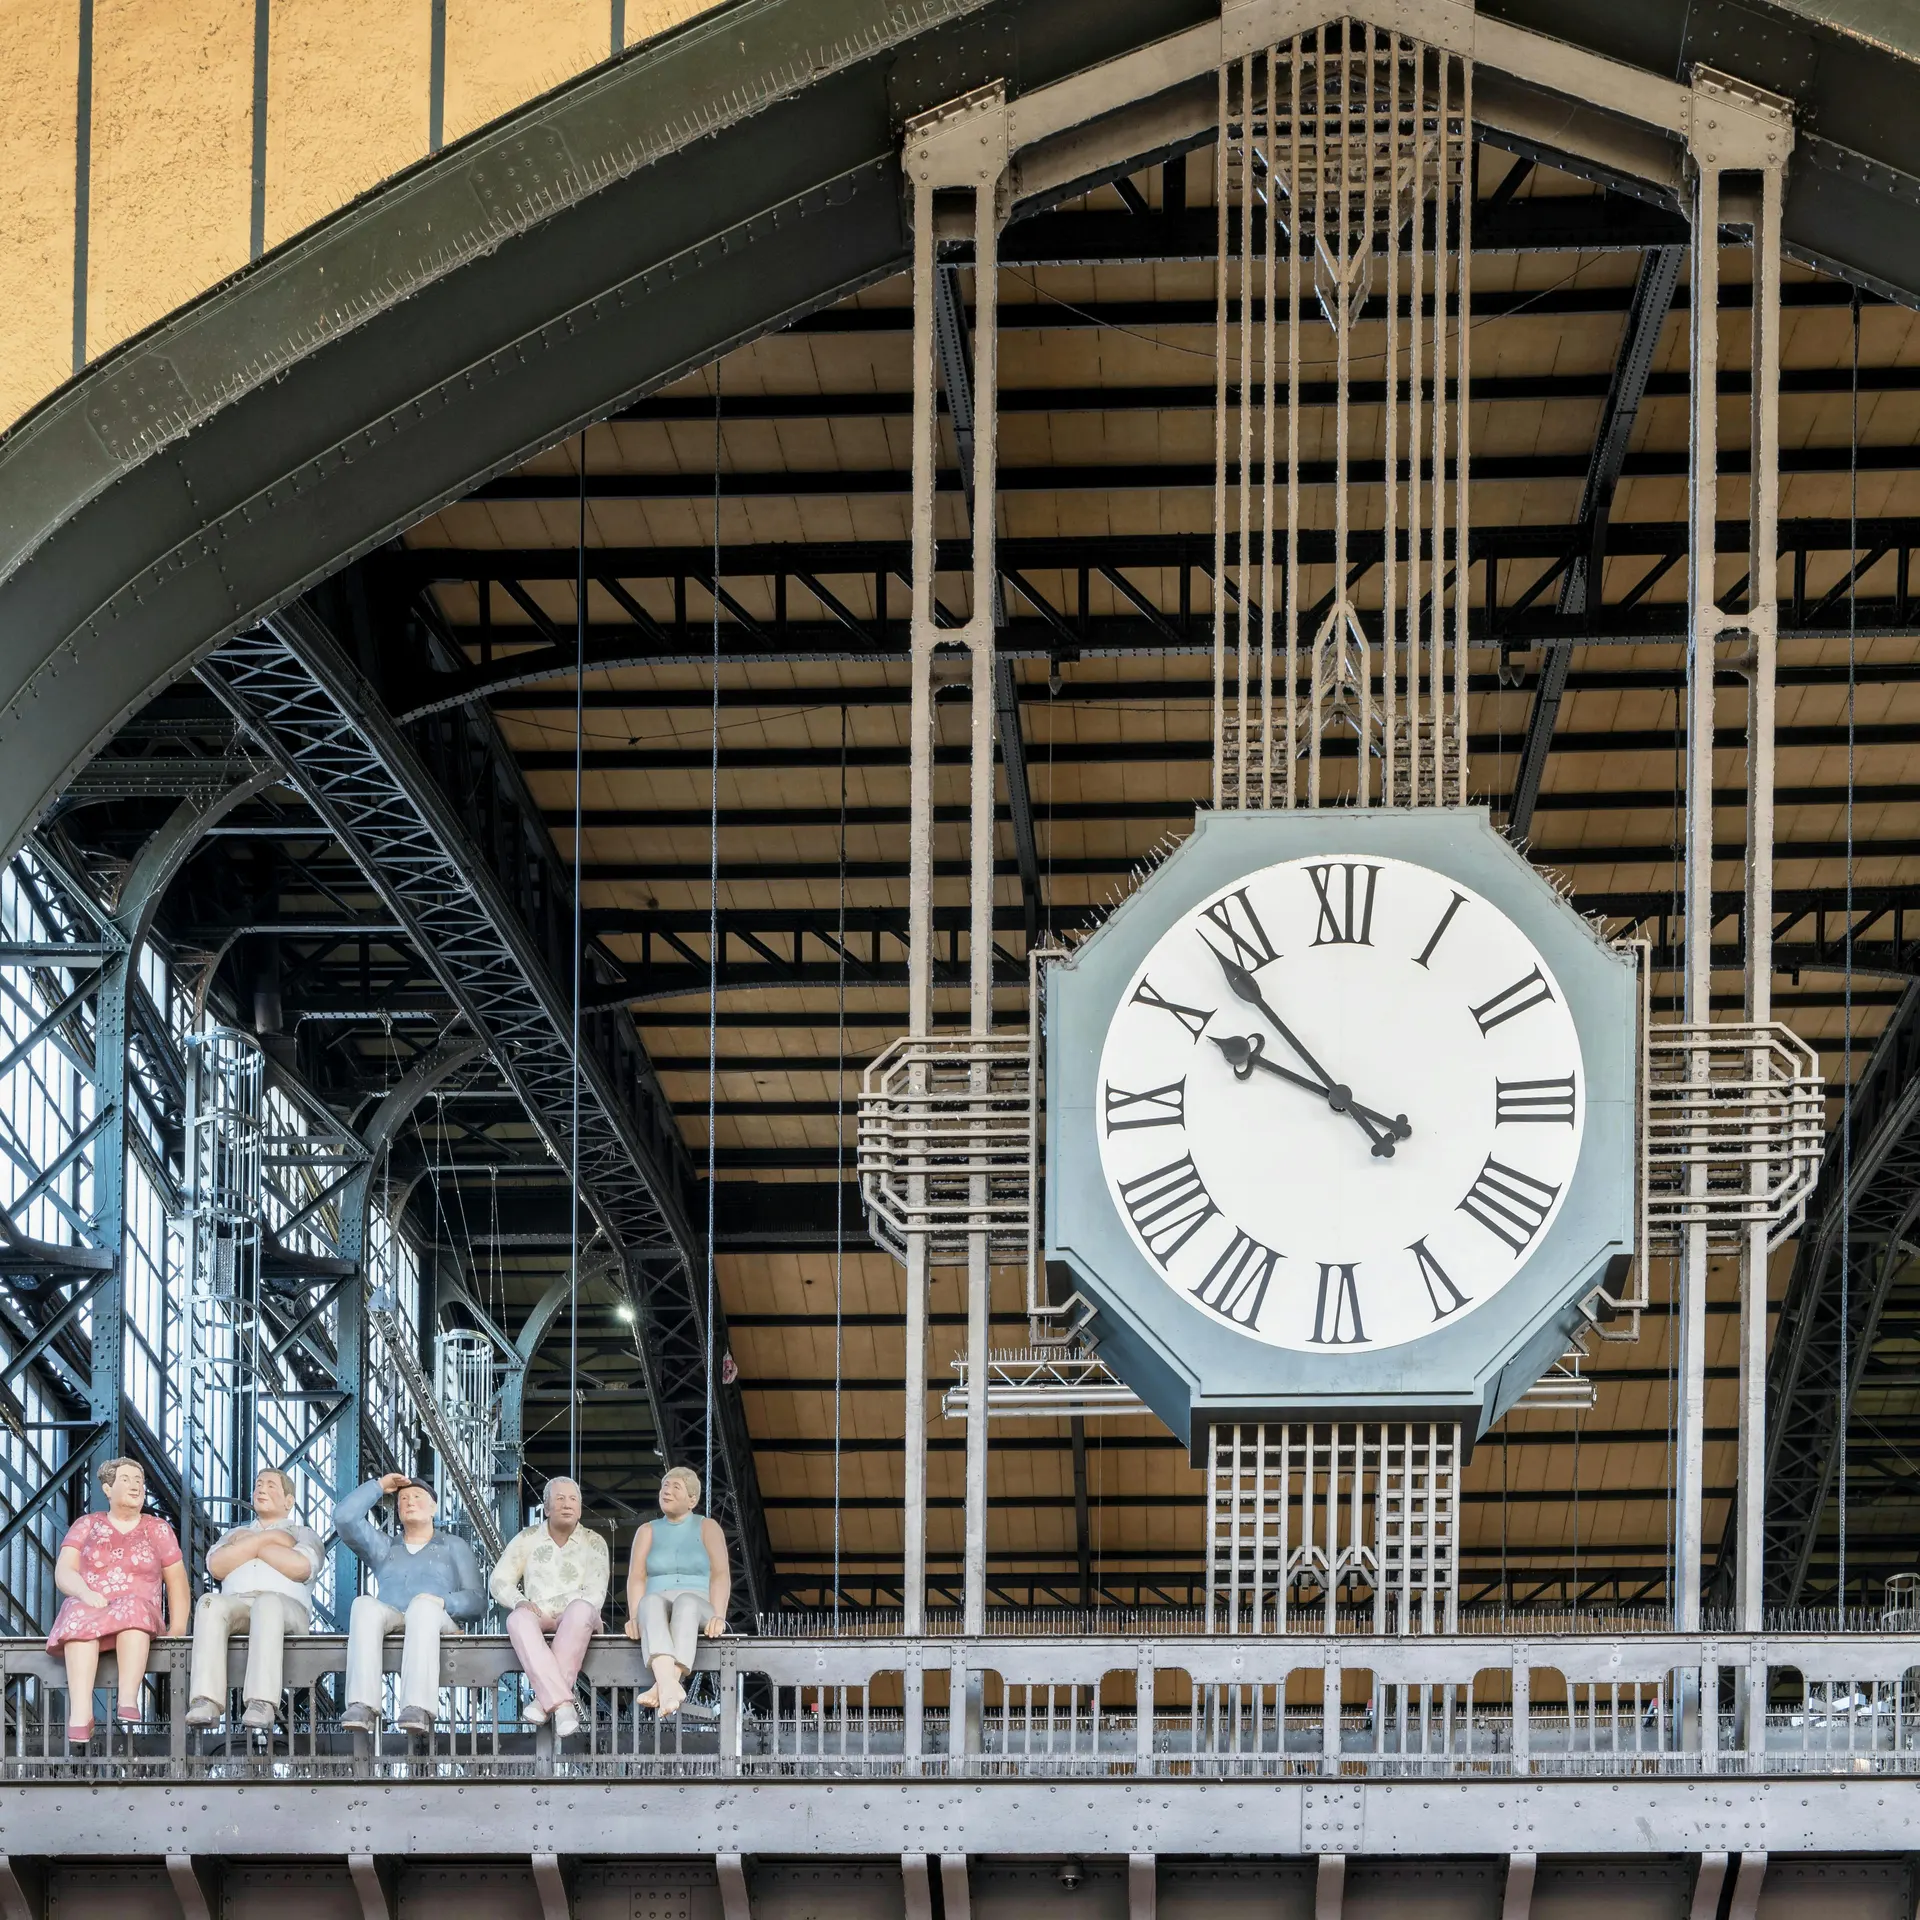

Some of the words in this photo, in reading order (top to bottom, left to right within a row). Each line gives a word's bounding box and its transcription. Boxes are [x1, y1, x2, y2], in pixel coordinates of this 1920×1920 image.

[1198, 885, 1284, 974] XI
[1301, 863, 1384, 947] XII
[1411, 890, 1470, 970] I
[1129, 973, 1217, 1045] X
[1468, 963, 1555, 1039] II
[1106, 1074, 1186, 1139] IX
[1495, 1070, 1575, 1129] III
[1117, 1149, 1225, 1271] VIII
[1455, 1152, 1562, 1259] IIII
[1188, 1226, 1287, 1332] VII
[1306, 1262, 1372, 1344] VI
[1405, 1234, 1473, 1322] V
